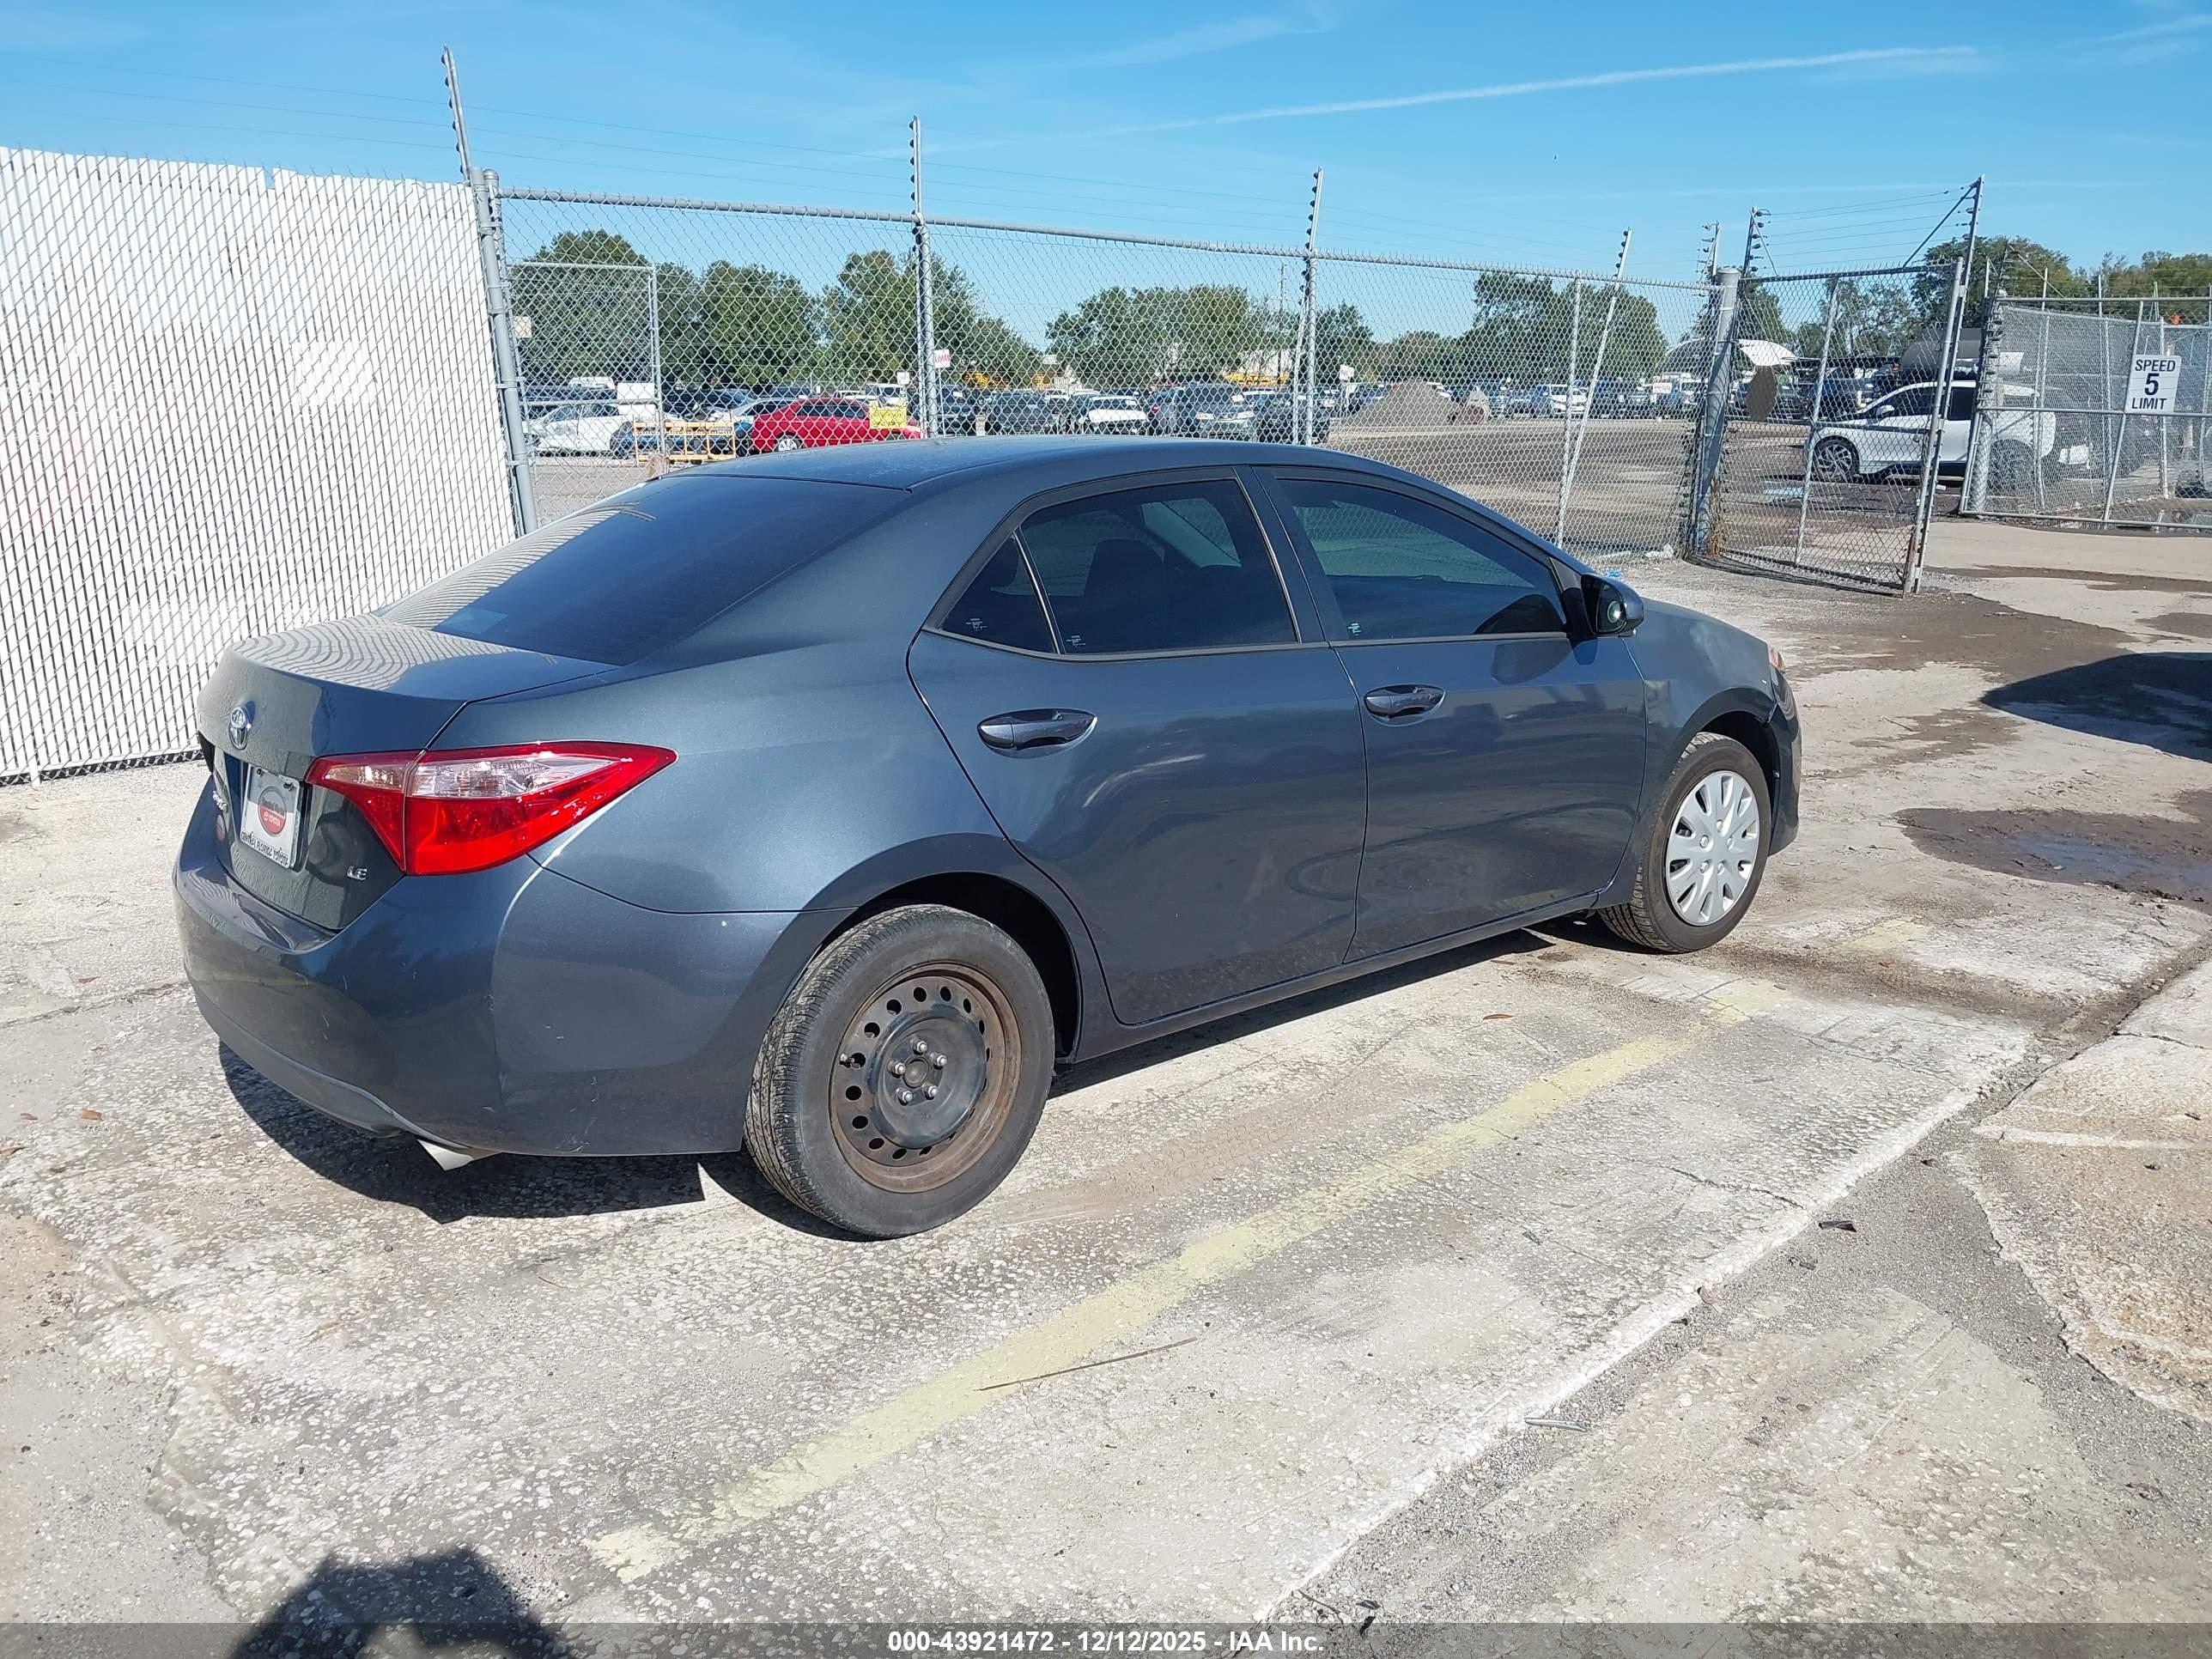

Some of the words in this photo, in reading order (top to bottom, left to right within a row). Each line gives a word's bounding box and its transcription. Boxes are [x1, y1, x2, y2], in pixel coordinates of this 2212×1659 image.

[2135, 359, 2176, 372] SPEED
[2144, 373, 2160, 396] 5
[2131, 398, 2166, 410] LIMIT
[347, 866, 368, 880] LE
